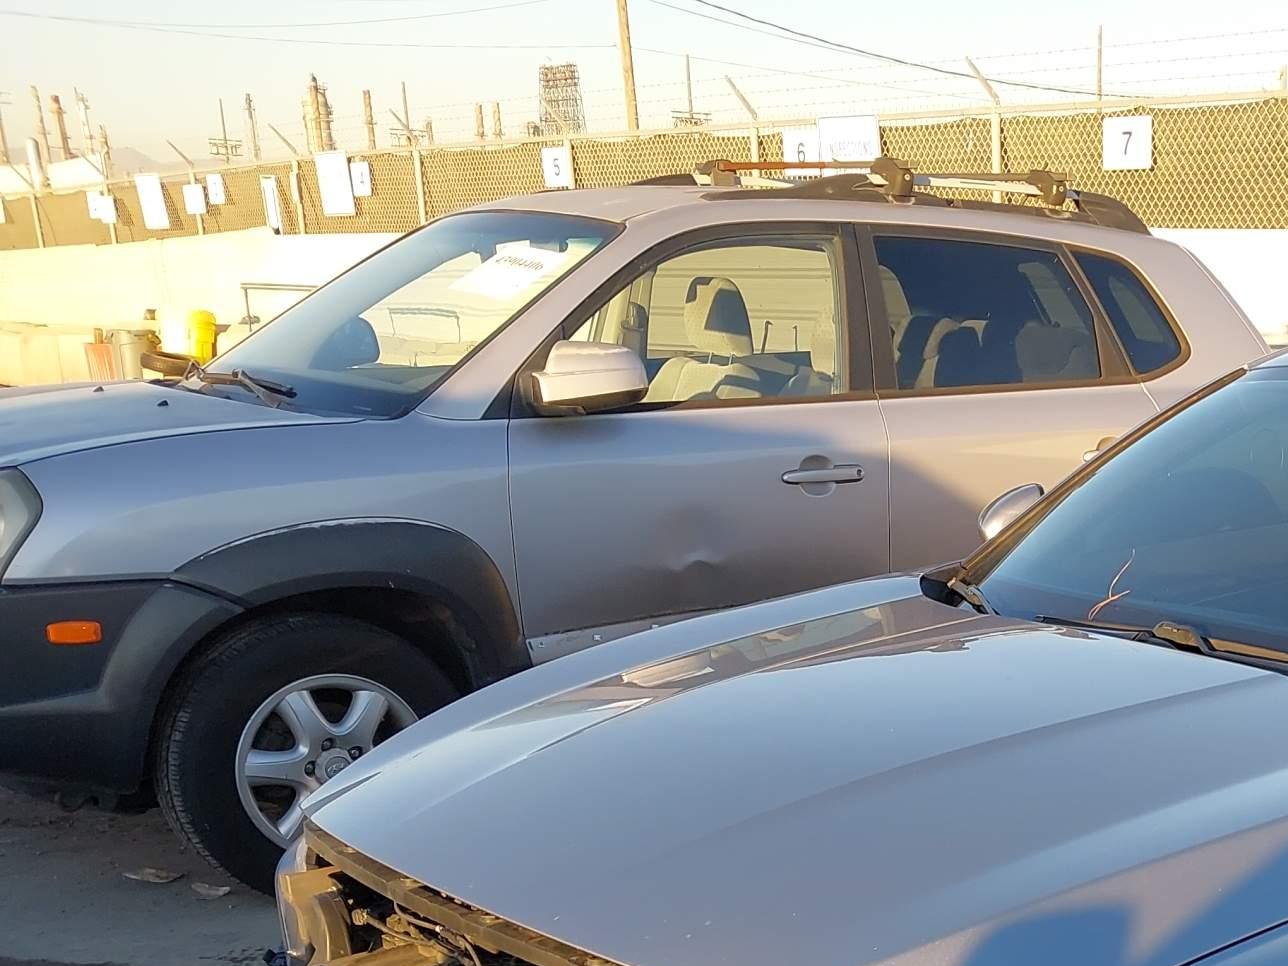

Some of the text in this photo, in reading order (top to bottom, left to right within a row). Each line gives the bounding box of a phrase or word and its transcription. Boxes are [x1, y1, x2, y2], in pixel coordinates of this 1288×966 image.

[797, 142, 806, 163] 6
[1122, 131, 1132, 155] 7
[552, 157, 561, 177] 5
